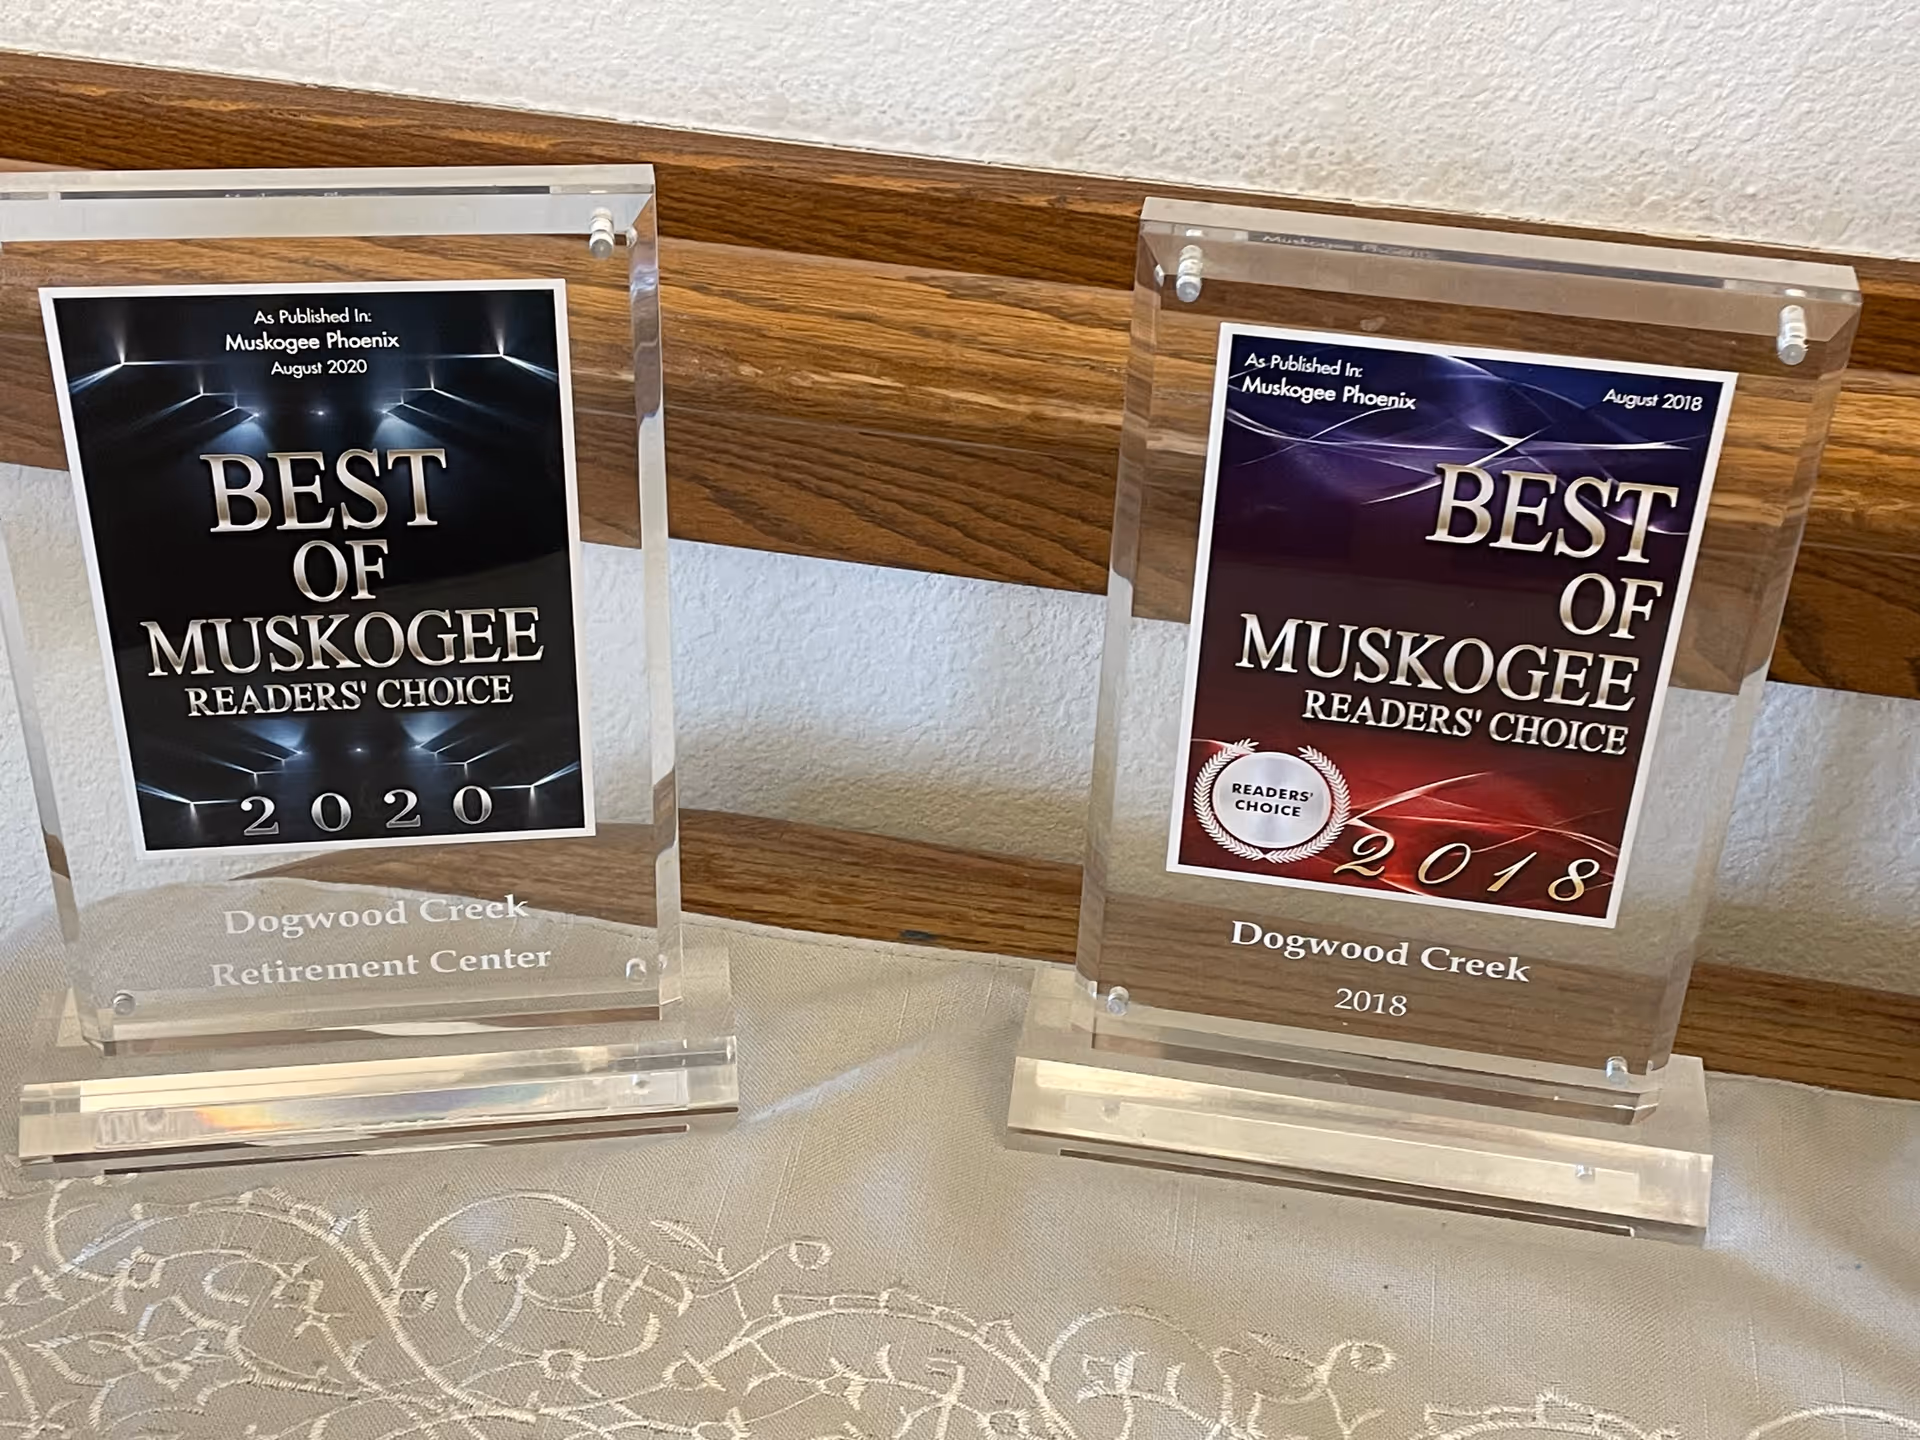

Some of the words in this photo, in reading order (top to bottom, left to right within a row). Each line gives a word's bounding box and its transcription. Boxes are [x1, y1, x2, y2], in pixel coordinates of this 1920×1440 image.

[253, 310, 275, 325] As
[279, 306, 350, 324] Published
[354, 308, 372, 323] In:
[225, 331, 320, 355] Muskogee
[326, 329, 400, 349] Phoenix
[271, 361, 322, 379] August
[326, 358, 368, 375] 2020
[1244, 353, 1267, 369] As
[1270, 354, 1342, 376] Published
[1345, 362, 1364, 378] In:
[1242, 376, 1336, 404] Muskogee
[1342, 384, 1417, 410] Phoenix
[1602, 388, 1660, 409] August
[1661, 393, 1704, 412] 2018
[200, 447, 447, 533] BEST
[1424, 462, 1680, 564] BEST
[292, 538, 389, 603] OF
[1559, 572, 1664, 640] OF
[139, 606, 544, 677] MUSKOGEE
[1234, 612, 1640, 713] MUSKOGEE
[184, 679, 368, 718] READERS'
[376, 674, 514, 709] CHOICE
[1302, 689, 1482, 738] READERS'
[1488, 712, 1629, 756] CHOICE
[1235, 799, 1302, 818] CHOICE
[222, 900, 409, 939] Dogwood
[419, 893, 530, 923] Creek
[211, 954, 420, 988] Retirement
[429, 947, 553, 974] Center
[1230, 920, 1409, 966] Dogwood
[1420, 946, 1531, 984] Creek
[1334, 987, 1409, 1018] 2018
